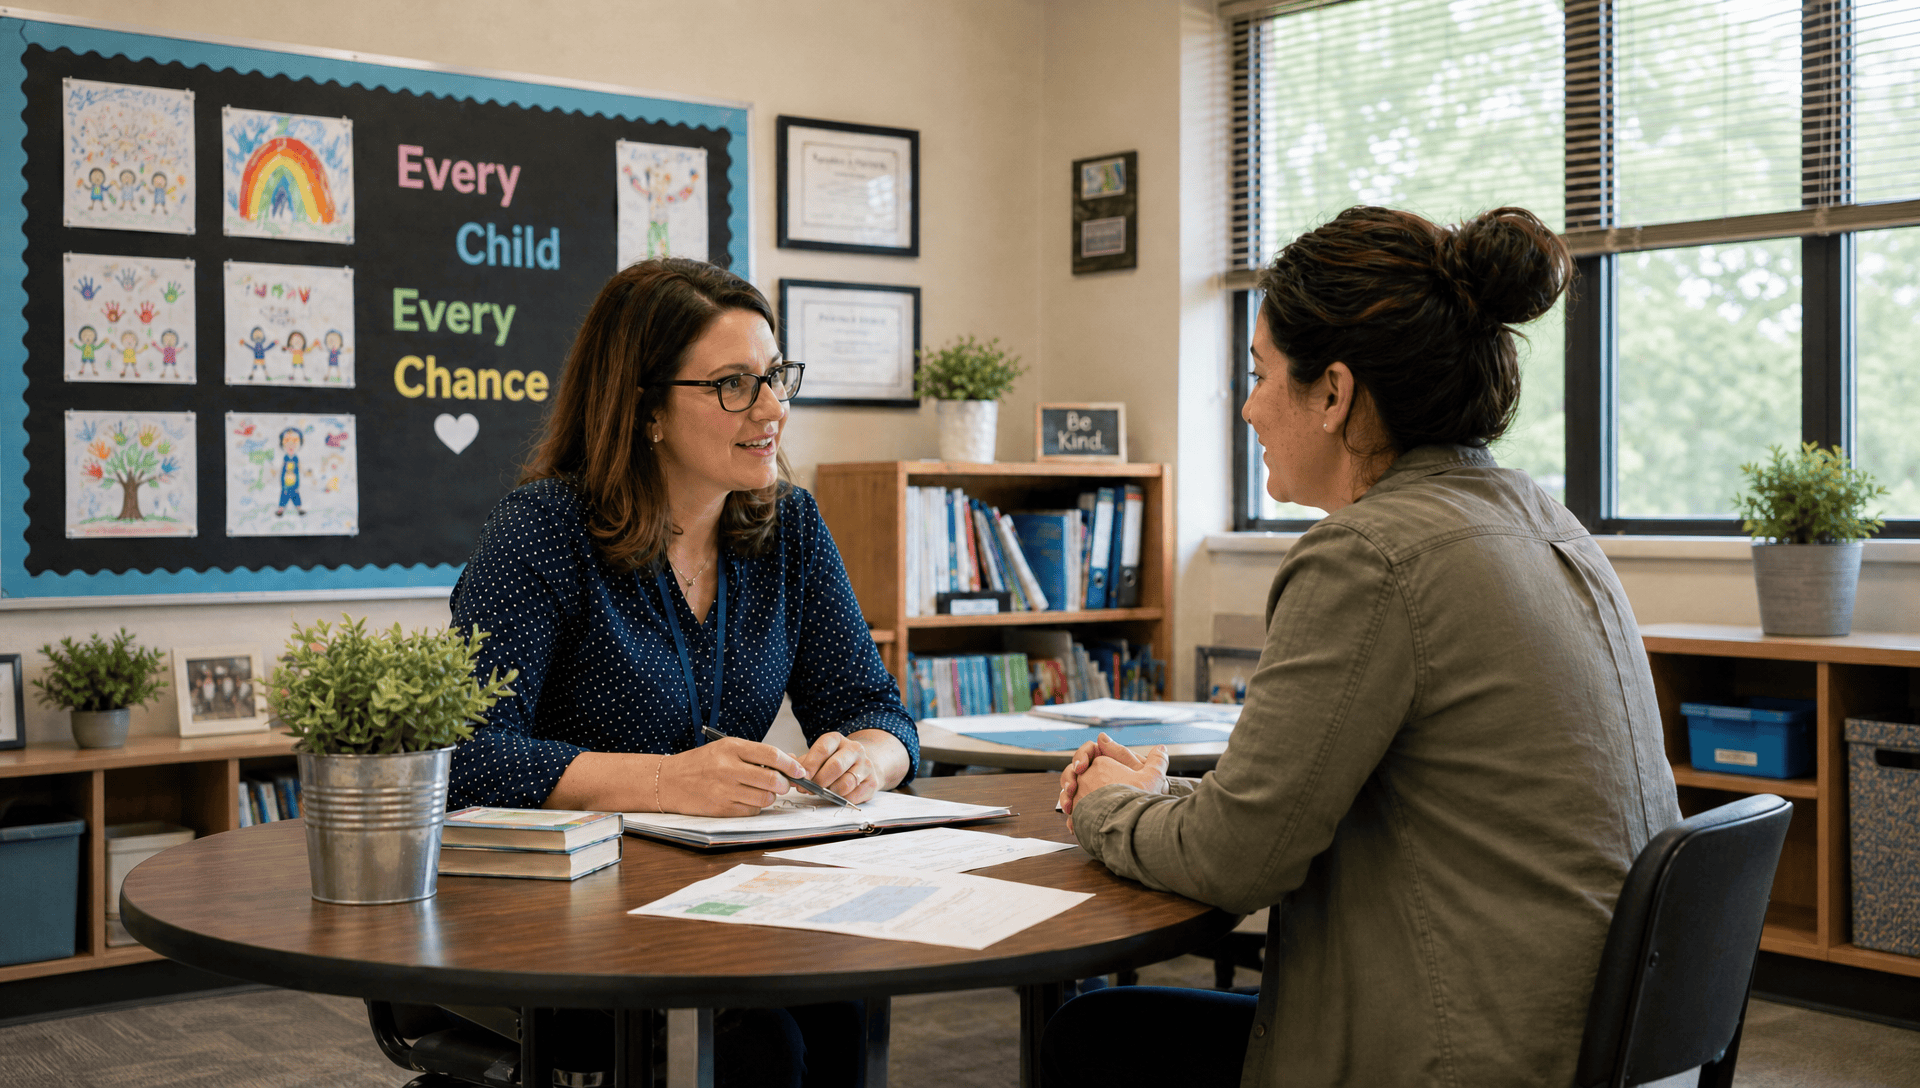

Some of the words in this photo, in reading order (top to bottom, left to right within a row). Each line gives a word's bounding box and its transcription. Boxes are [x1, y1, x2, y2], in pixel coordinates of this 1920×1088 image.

[398, 143, 521, 208] Every
[456, 221, 560, 270] Child
[393, 287, 516, 347] Every
[393, 355, 549, 402] Chance
[1066, 410, 1092, 431] Be
